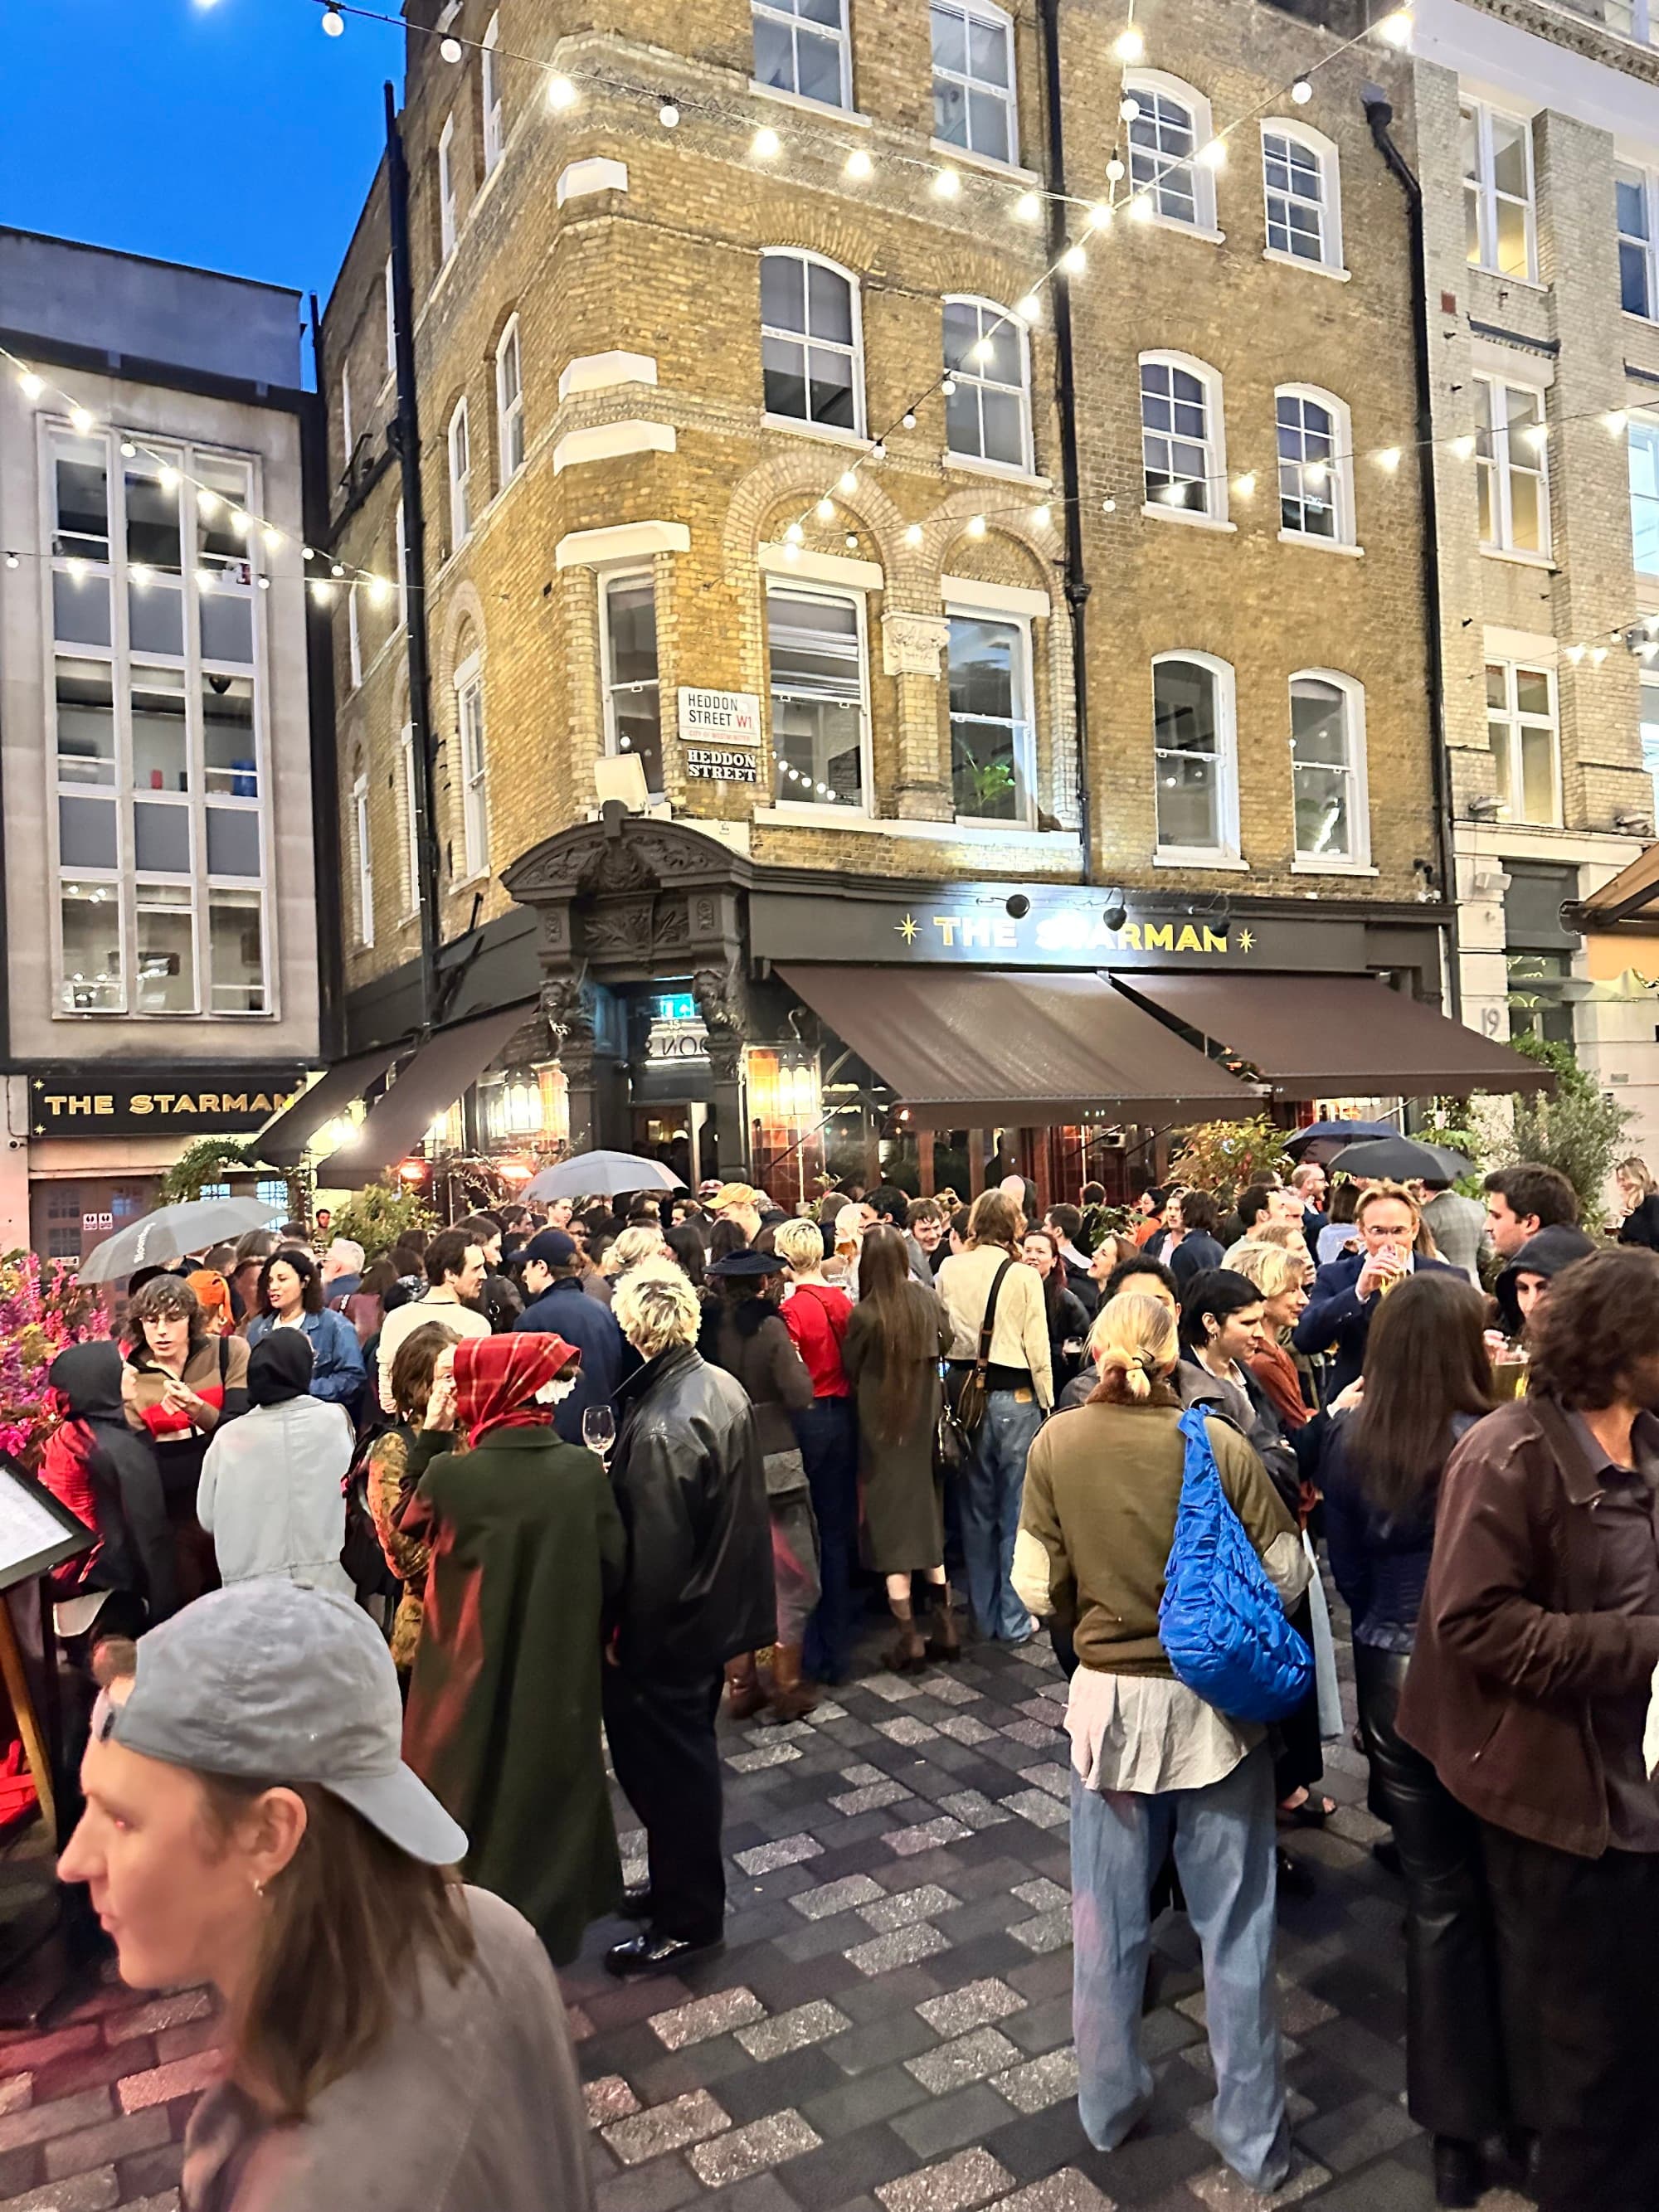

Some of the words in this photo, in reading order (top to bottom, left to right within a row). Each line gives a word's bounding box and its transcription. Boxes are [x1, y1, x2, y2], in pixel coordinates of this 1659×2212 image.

[688, 693, 738, 712] HEDDON
[689, 709, 732, 727] STREET
[736, 715, 752, 729] W1
[688, 749, 756, 768] HEDDON
[688, 764, 756, 782] STREET
[933, 916, 1018, 949] THE
[1035, 919, 1228, 953] SARMAN
[44, 1095, 114, 1116] THE
